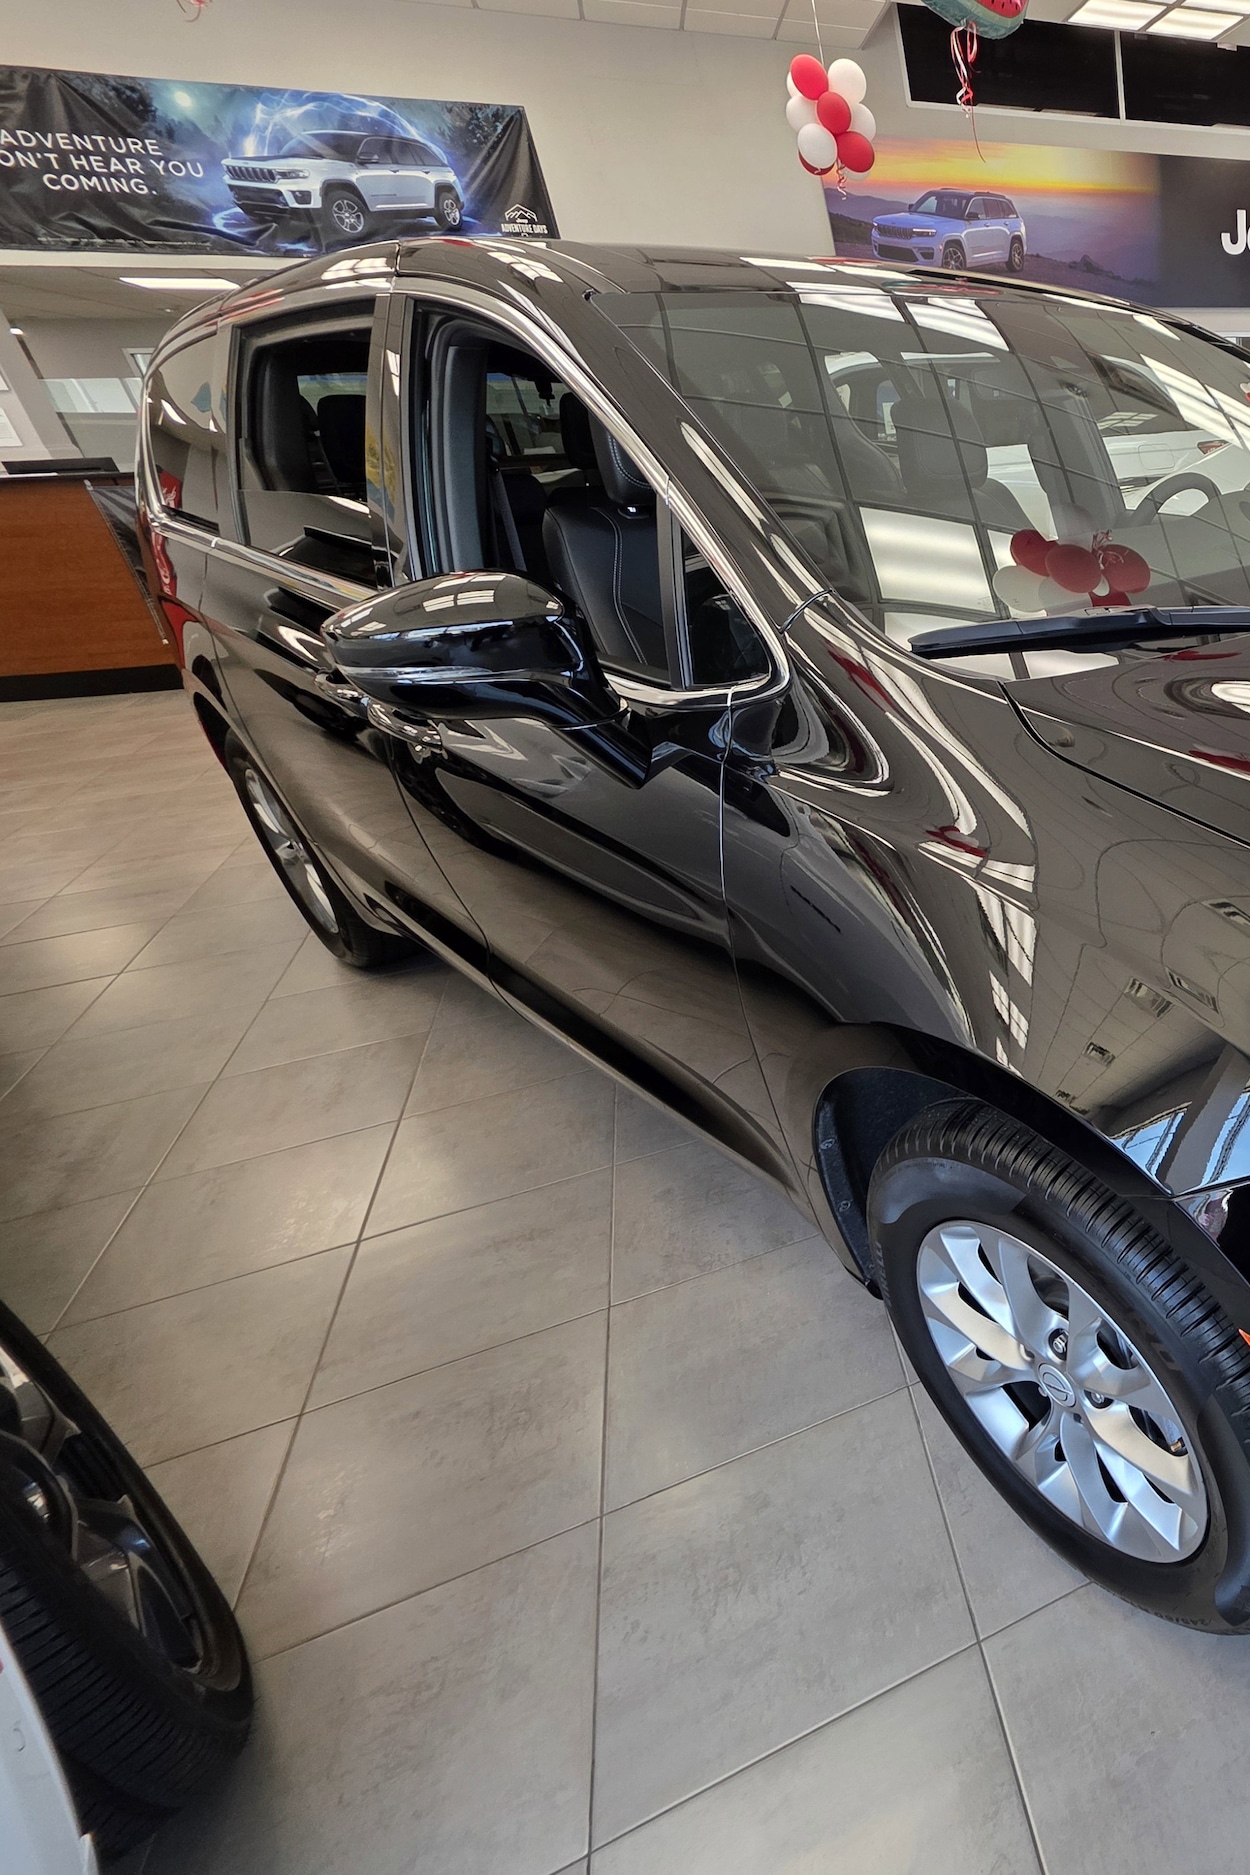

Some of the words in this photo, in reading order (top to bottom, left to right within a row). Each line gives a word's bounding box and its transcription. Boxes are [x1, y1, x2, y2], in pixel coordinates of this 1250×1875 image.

[0, 129, 164, 156] ADVENTURE
[0, 151, 60, 170] ON'T
[69, 154, 146, 174] HEAR
[150, 159, 204, 178] YOU
[42, 173, 158, 195] COMING.
